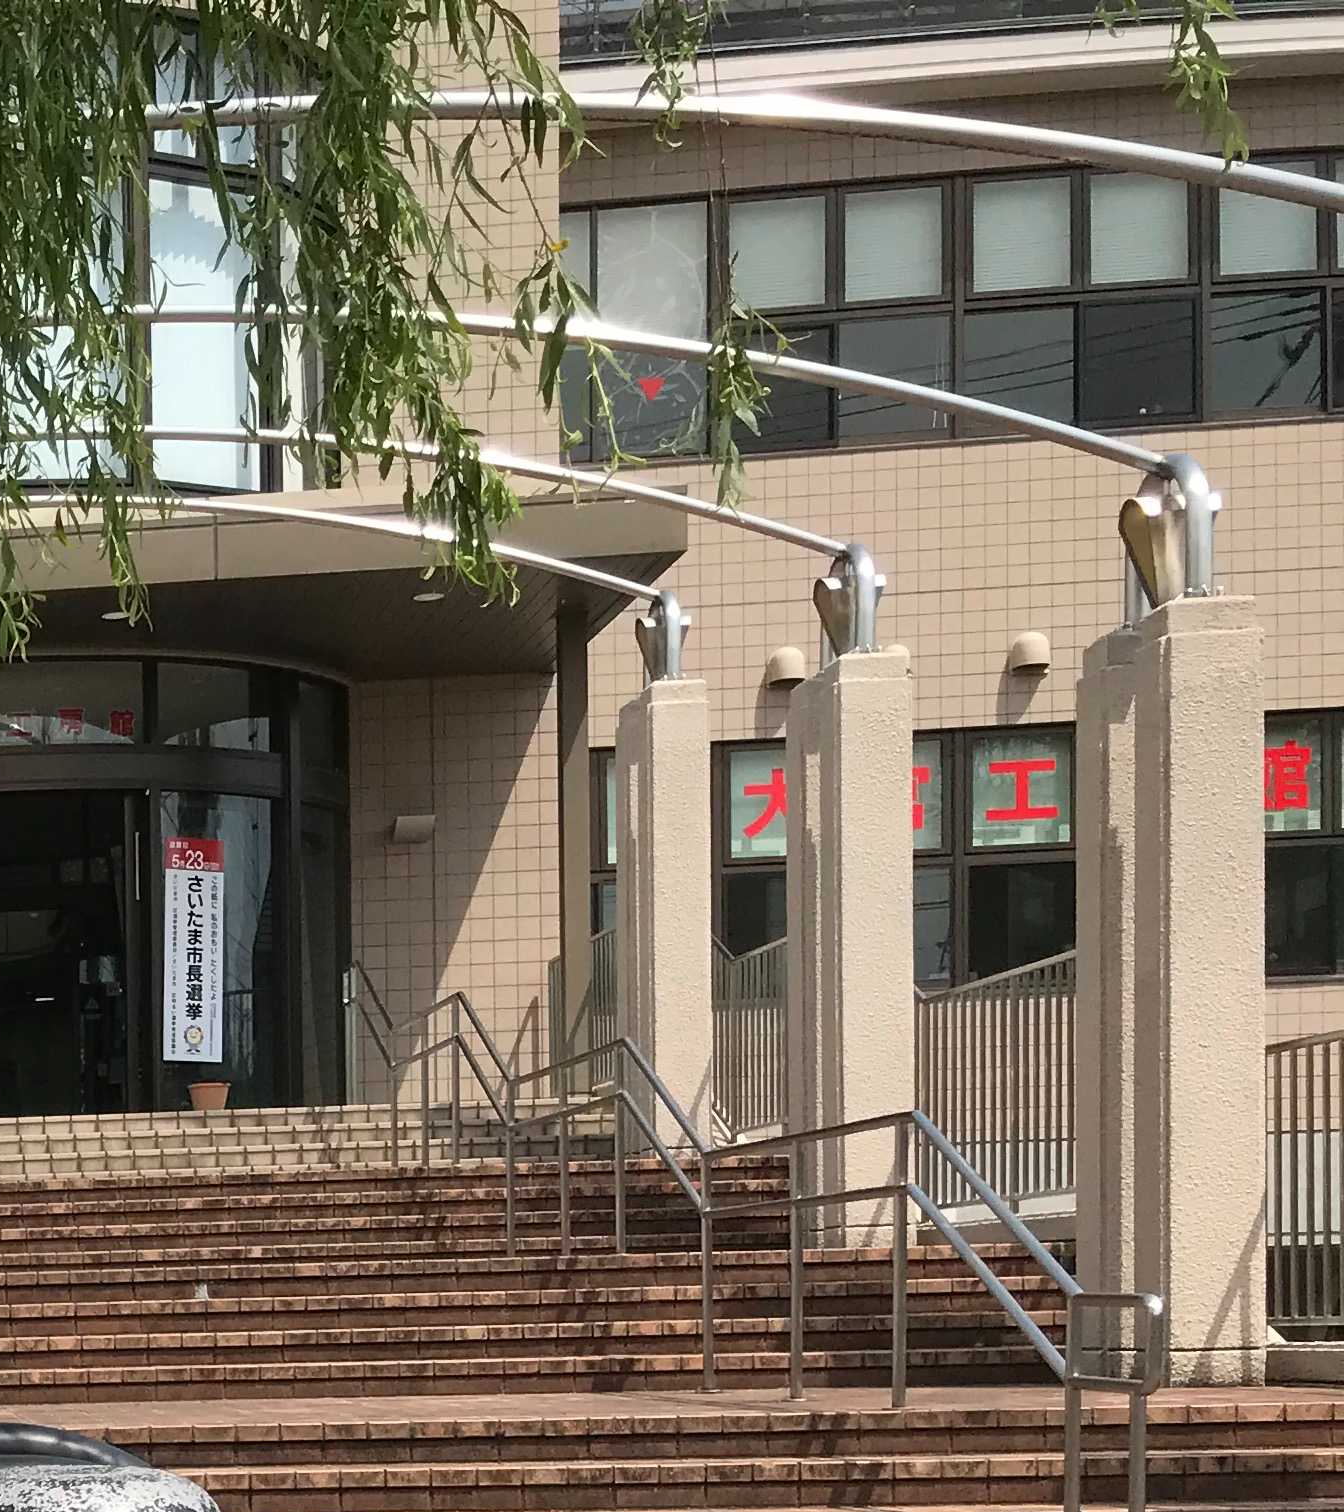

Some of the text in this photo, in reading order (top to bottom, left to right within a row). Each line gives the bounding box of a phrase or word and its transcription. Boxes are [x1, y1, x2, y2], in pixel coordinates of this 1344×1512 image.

[185, 875, 204, 1021] さいたま市長選挙
